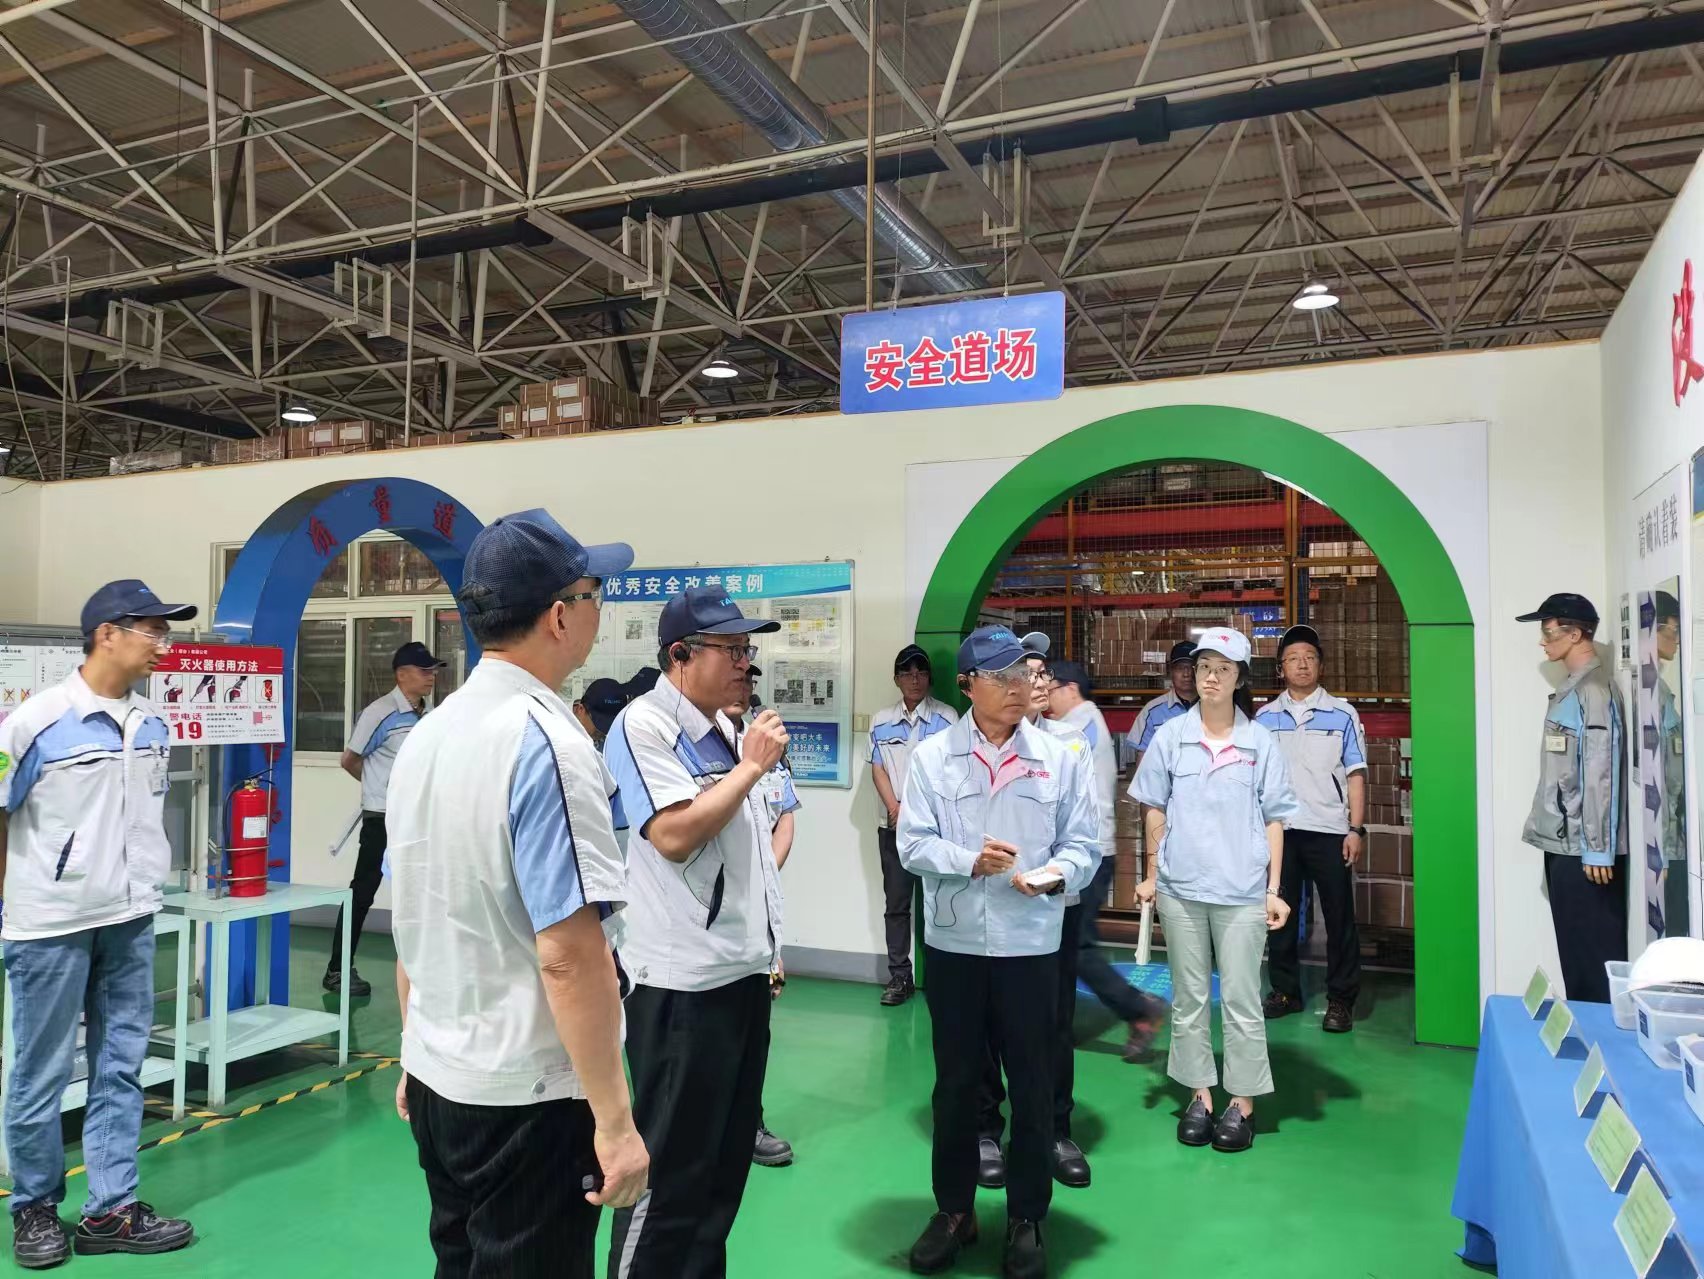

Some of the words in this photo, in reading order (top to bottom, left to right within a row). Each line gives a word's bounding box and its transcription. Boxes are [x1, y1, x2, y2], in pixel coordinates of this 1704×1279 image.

[865, 328, 1037, 393] 安全道场
[180, 658, 258, 672] 灭火器使用方法
